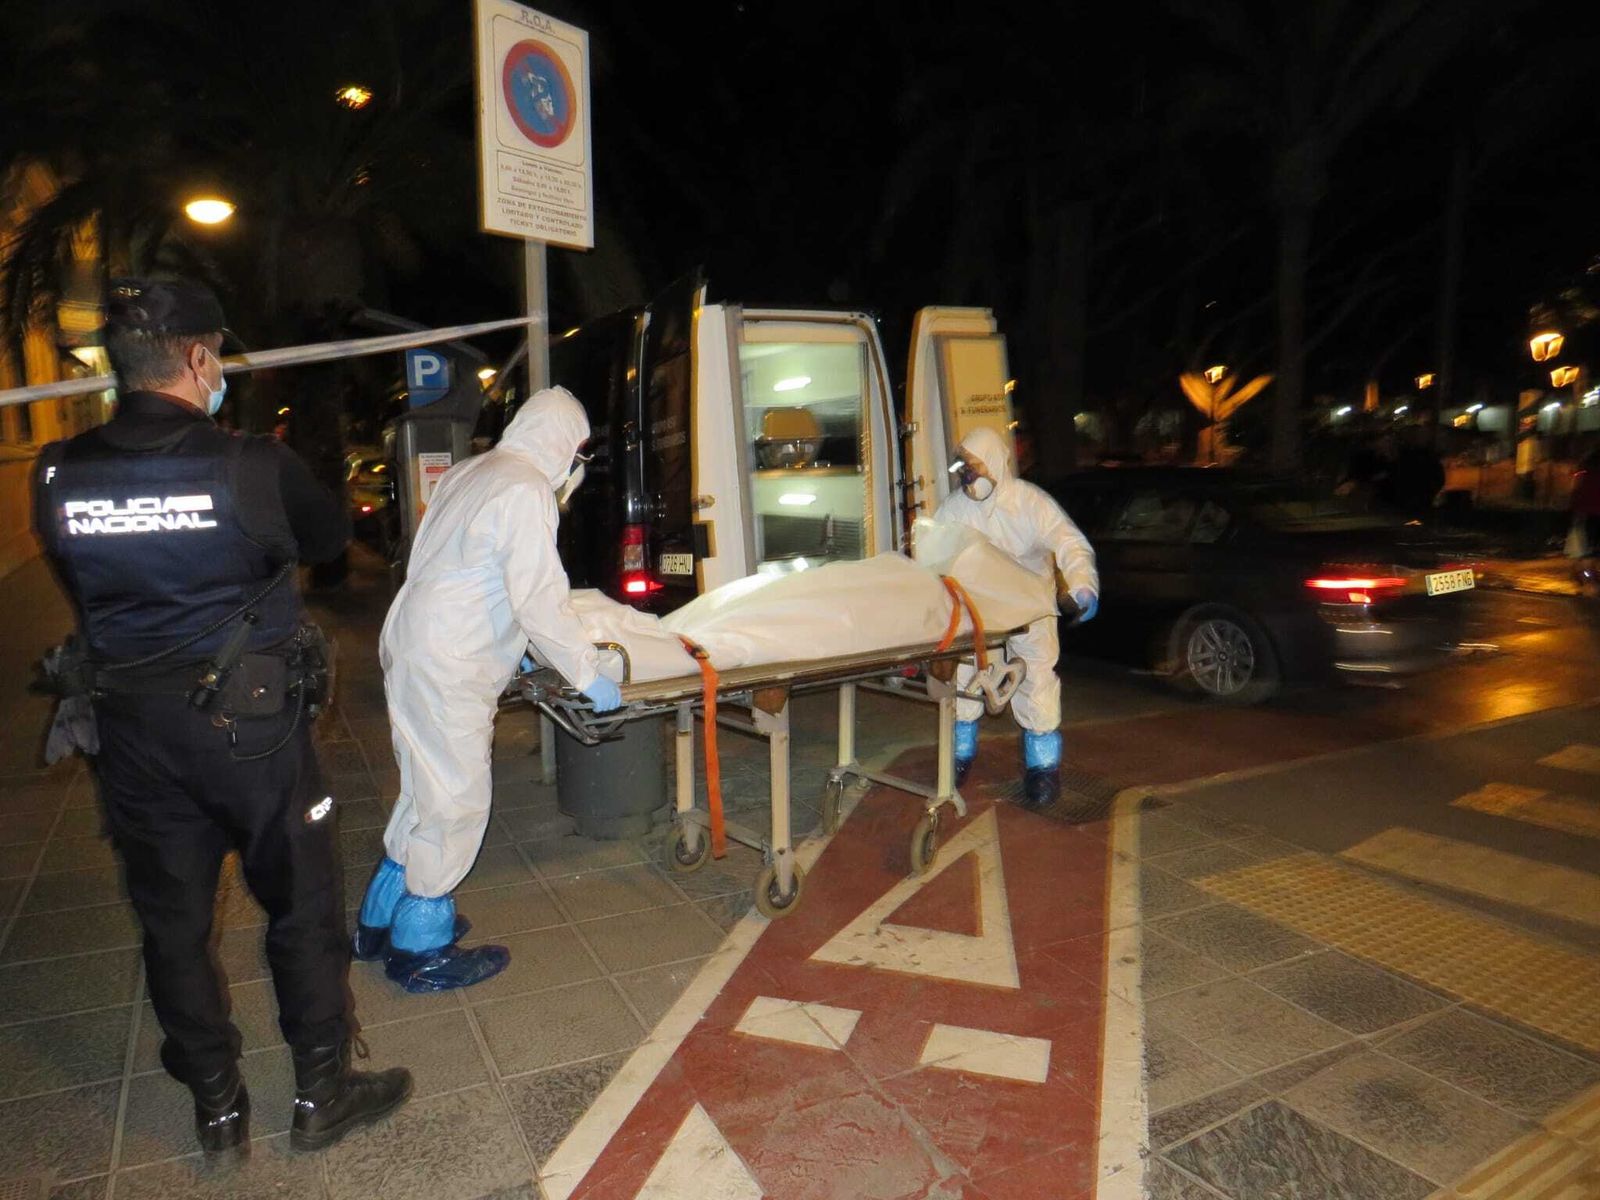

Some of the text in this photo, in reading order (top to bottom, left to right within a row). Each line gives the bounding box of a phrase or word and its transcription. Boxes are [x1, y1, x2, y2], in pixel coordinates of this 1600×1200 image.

[497, 197, 516, 206] ZONA
[414, 355, 440, 386] P
[65, 497, 181, 517] POLICIA
[68, 512, 217, 535] NACIONAL
